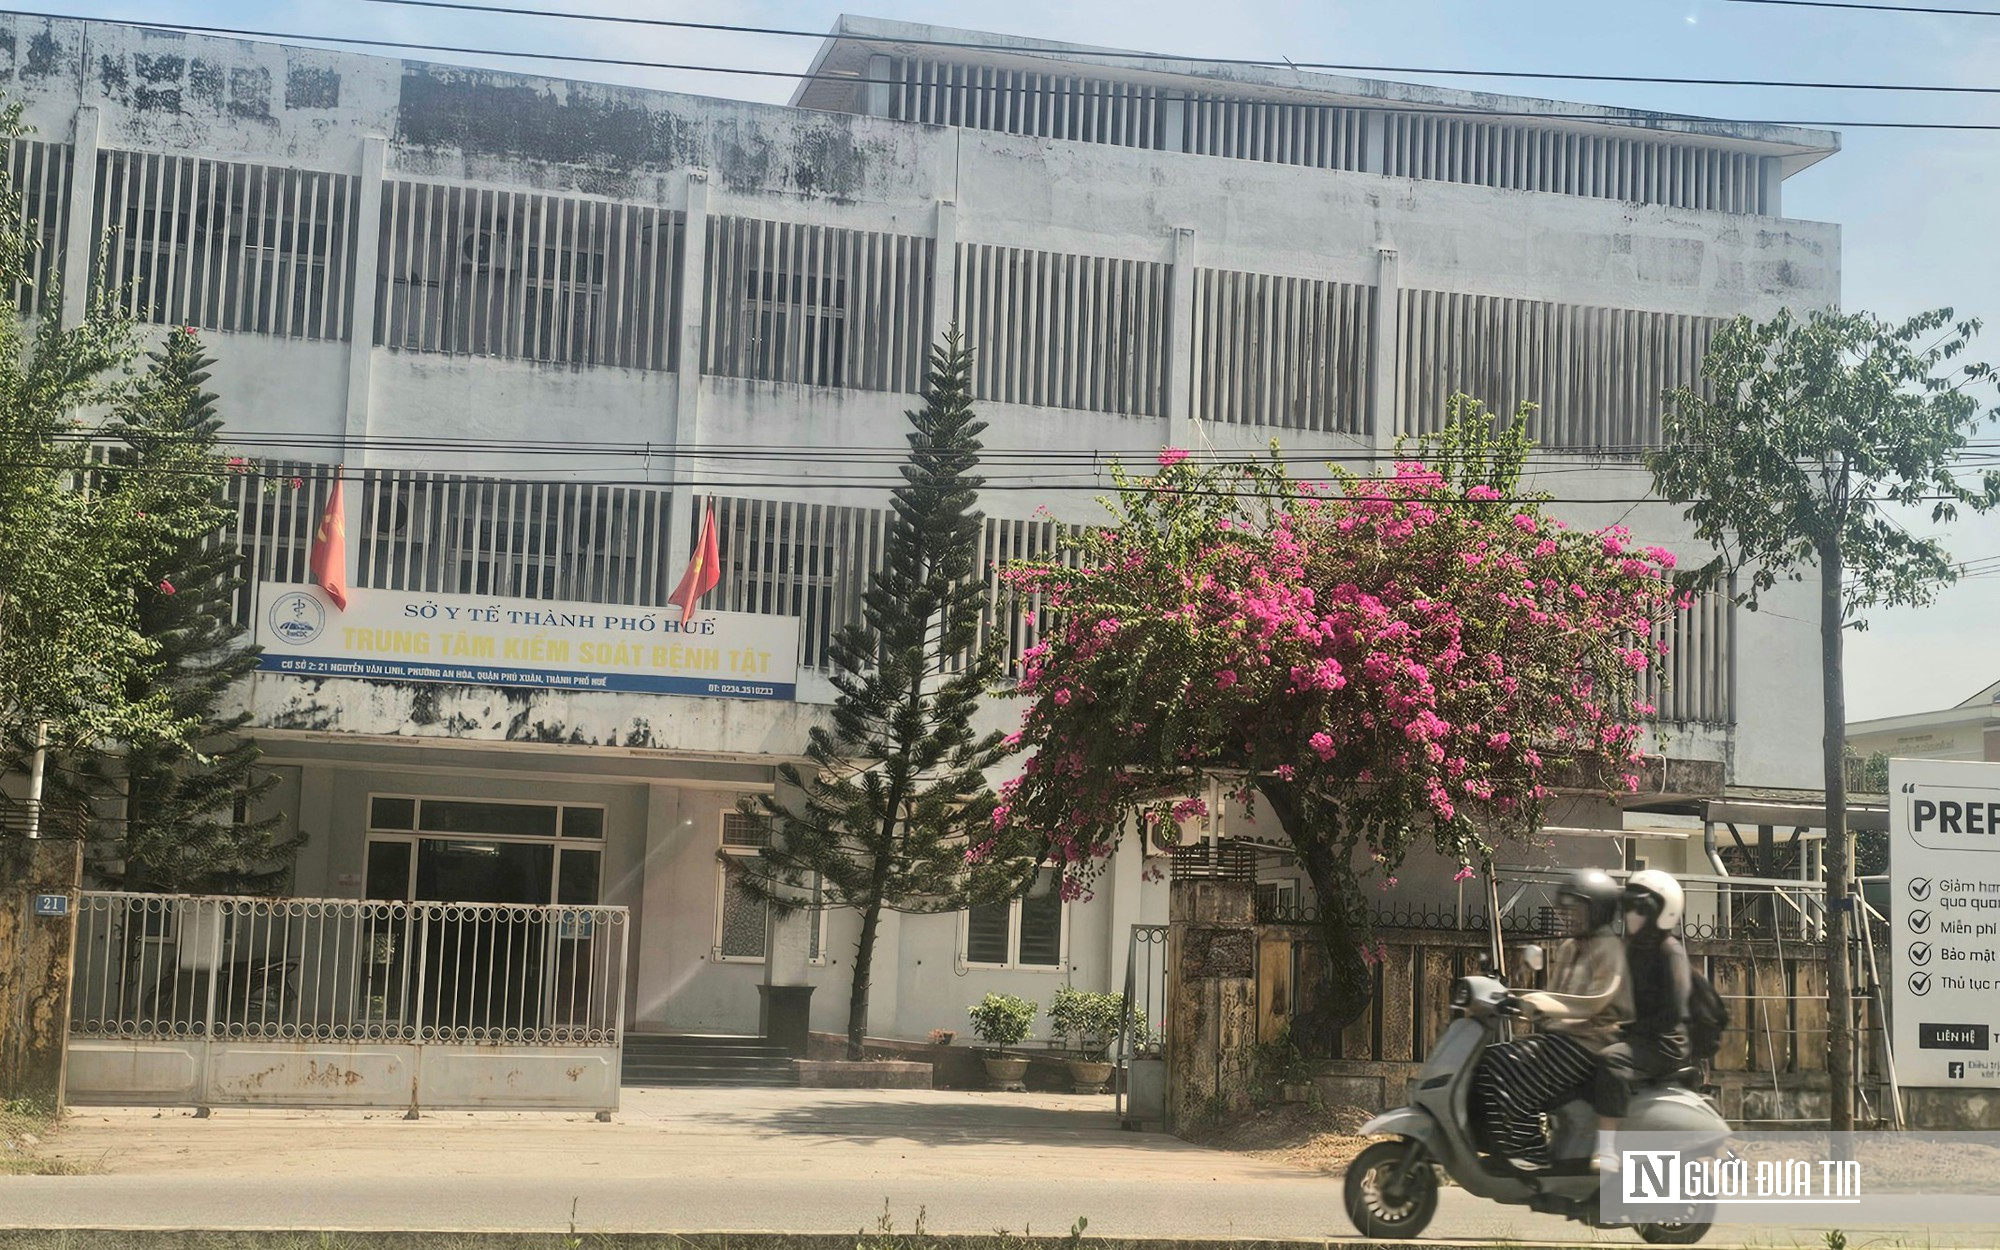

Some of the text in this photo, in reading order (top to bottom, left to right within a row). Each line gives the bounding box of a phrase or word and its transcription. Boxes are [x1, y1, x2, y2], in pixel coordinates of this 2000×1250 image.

[404, 600, 717, 636] SỞ Y TẾ THÀNH PHỐ HUẾ
[342, 626, 772, 677] TRUNG TÂM KIỂM SOÁT BỆNH TẬT
[281, 660, 293, 669] CƠ
[294, 659, 306, 670] SỞ
[318, 662, 328, 671] 21
[330, 662, 364, 673] NGUYỄN
[365, 664, 382, 674] VĂN
[407, 666, 440, 677] PHƯỜNG
[442, 669, 455, 678] AN
[477, 670, 499, 682] QUẬN
[501, 671, 517, 682] PHÚ
[519, 673, 544, 684] XUÂN,
[546, 674, 572, 685] THÀNH
[573, 674, 590, 686] PHỐ
[591, 676, 607, 687] HUẾ
[1939, 878, 1975, 893] Giảm
[43, 897, 58, 910] 21
[1940, 897, 1967, 911] qua
[1941, 919, 1997, 938] Miễn phí
[1941, 946, 1996, 963] Bảo mật
[1941, 975, 1965, 989] Thủ
[1969, 978, 1990, 991] tục
[1936, 1029, 1959, 1042] LIÊN
[1961, 1029, 1975, 1045] HỆ
